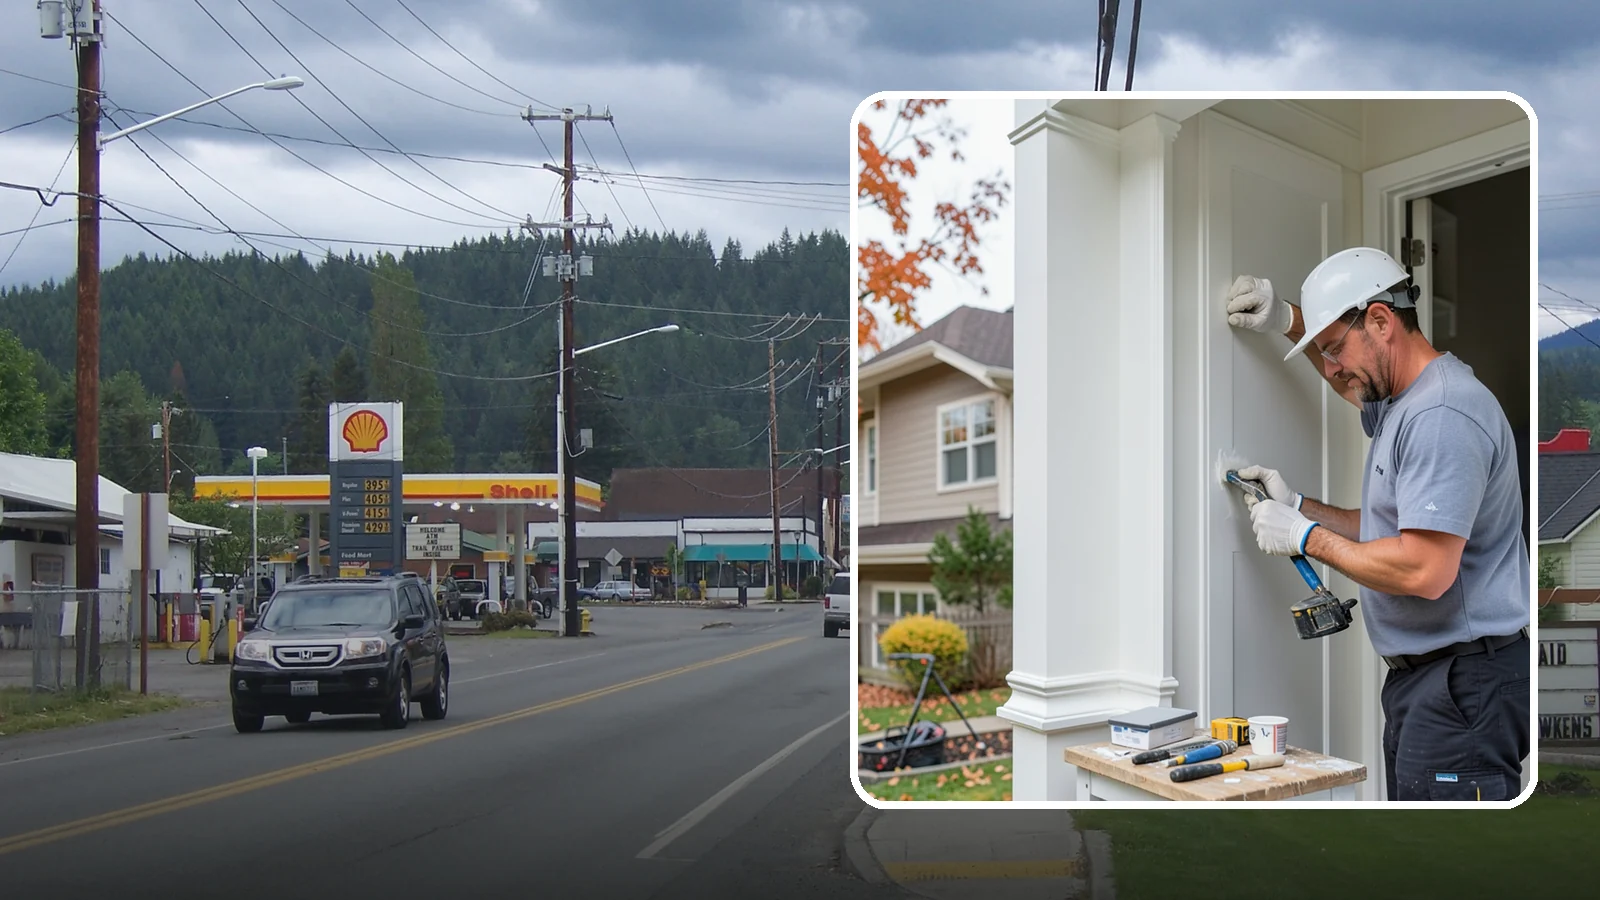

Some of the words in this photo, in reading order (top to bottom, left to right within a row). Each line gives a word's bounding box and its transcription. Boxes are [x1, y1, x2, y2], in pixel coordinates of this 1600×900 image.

[366, 480, 384, 490] 395
[490, 484, 547, 499] Shell
[366, 494, 383, 504] 405
[366, 508, 383, 518] 415
[366, 522, 383, 533] 429
[1539, 643, 1567, 665] AID
